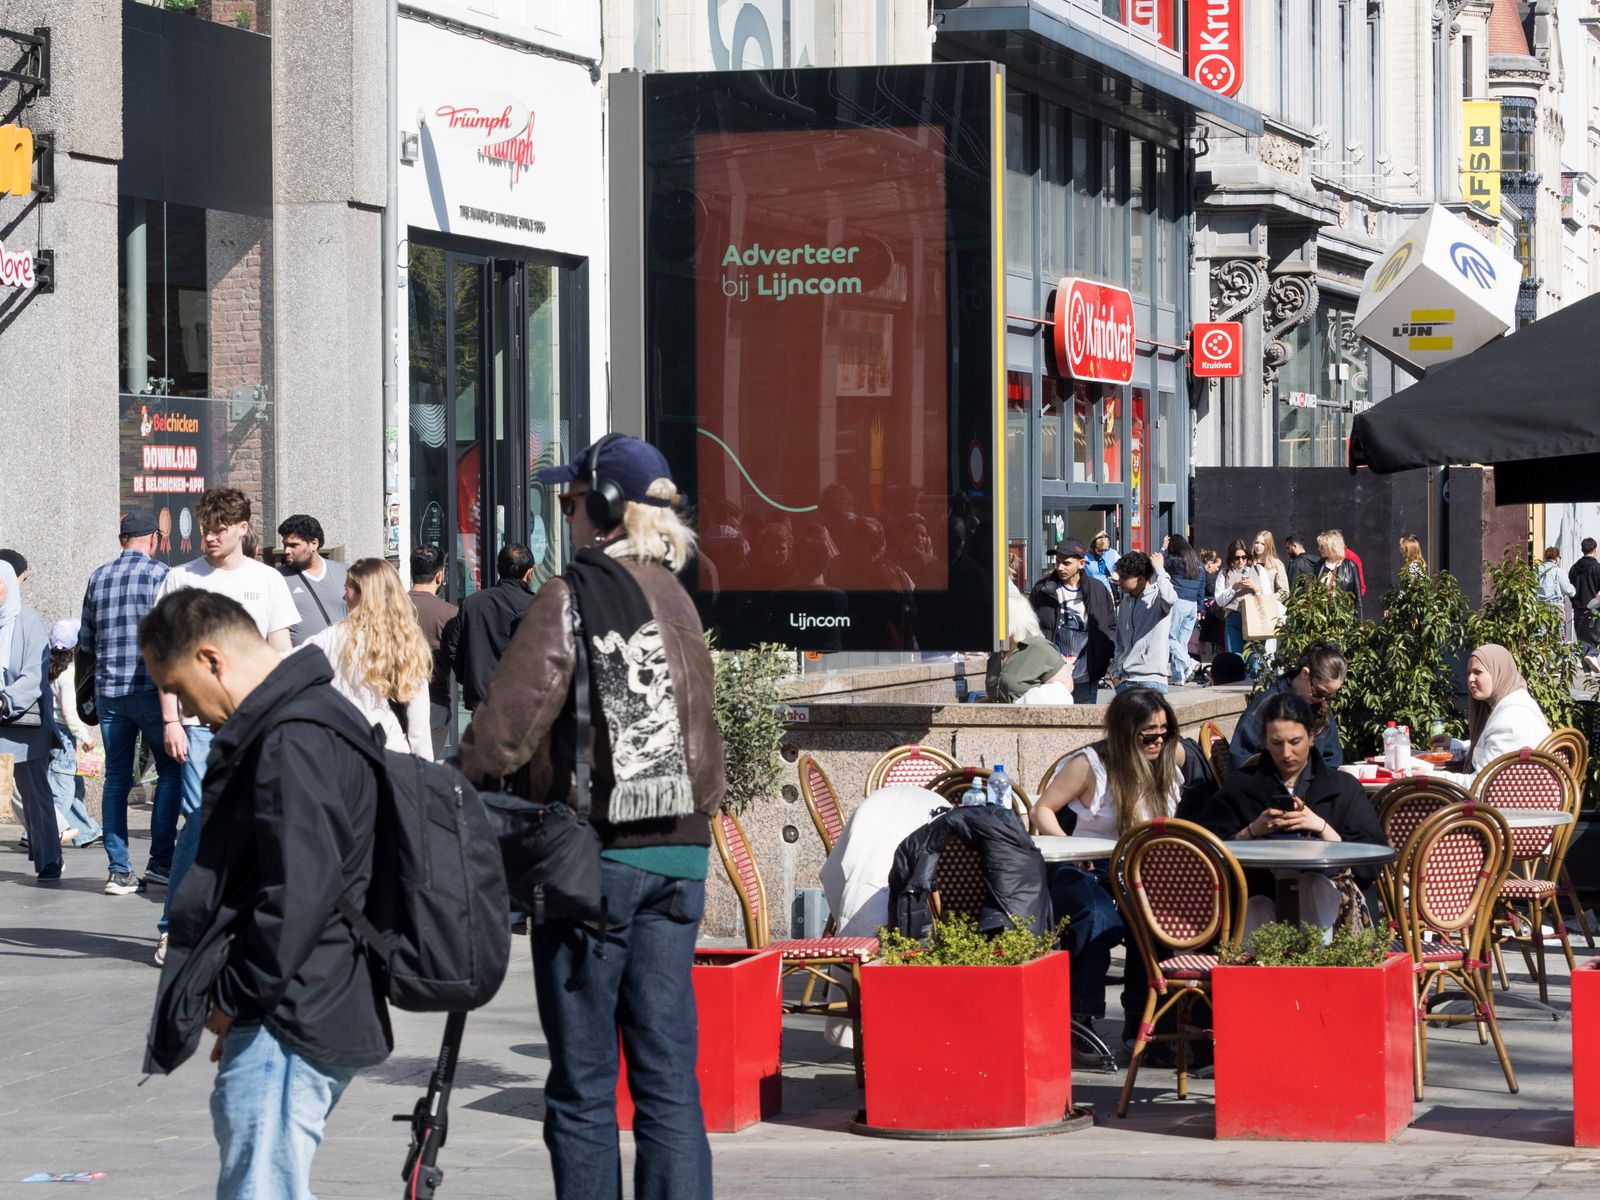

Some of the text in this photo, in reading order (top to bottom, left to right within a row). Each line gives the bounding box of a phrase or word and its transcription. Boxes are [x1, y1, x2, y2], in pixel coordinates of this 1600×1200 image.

[436, 105, 513, 137] Triumph
[0, 248, 32, 281] ore
[721, 243, 859, 266] Adverteer
[722, 272, 862, 302] bij Lijncom
[1086, 302, 1132, 364] Kruidvat
[1202, 361, 1232, 369] Kruidvat
[153, 412, 199, 433] Belchicken
[143, 446, 197, 470] DOWNLOAD
[133, 476, 144, 493] DE
[790, 612, 851, 630] Lijncom
